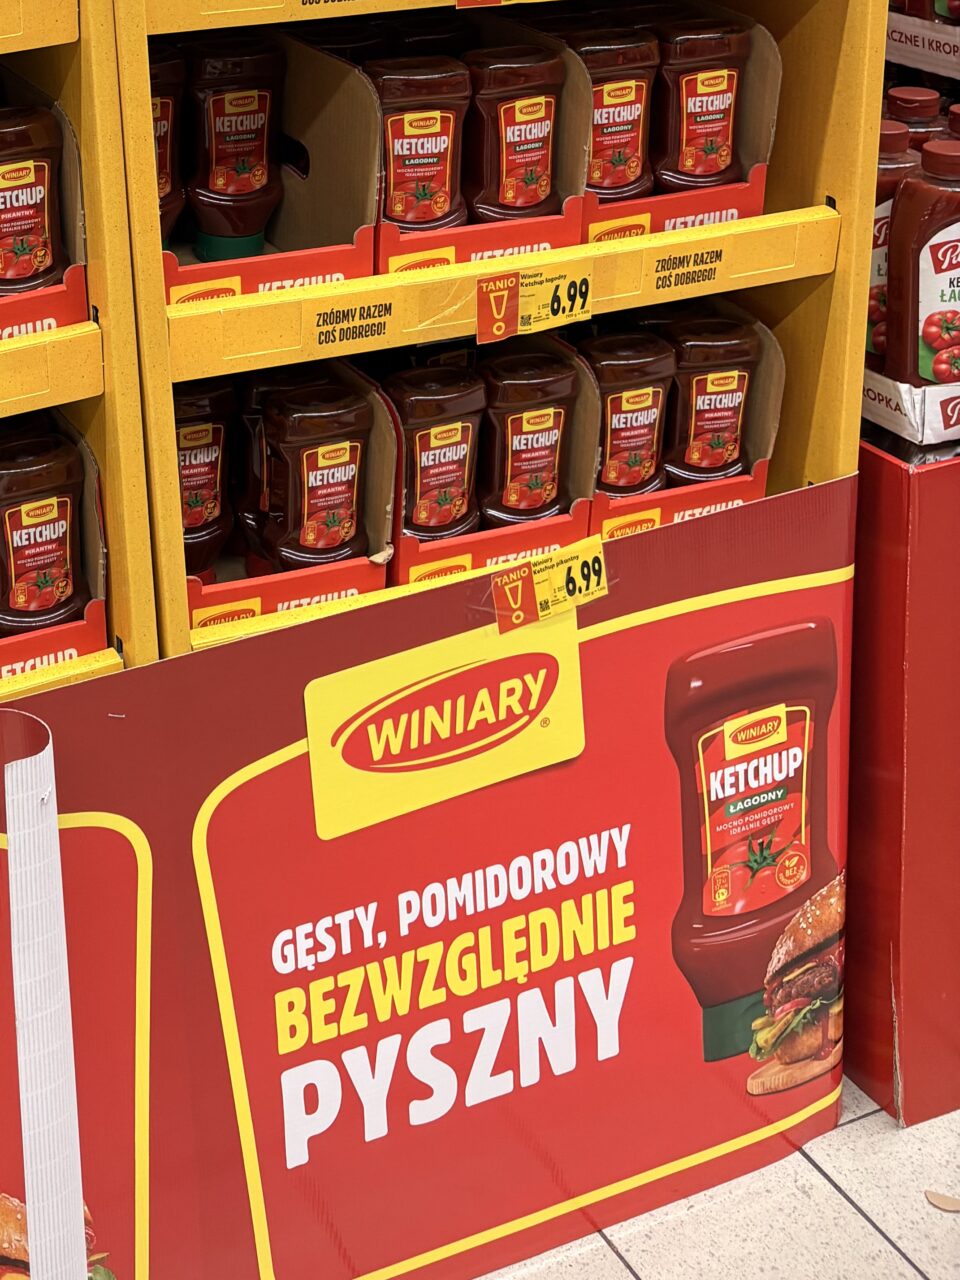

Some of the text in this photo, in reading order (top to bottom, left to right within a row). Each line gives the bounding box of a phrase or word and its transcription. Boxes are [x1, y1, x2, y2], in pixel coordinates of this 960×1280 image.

[394, 135, 448, 155] KETCHUP
[480, 277, 516, 292] TANIO
[550, 277, 590, 316] 6.99
[611, 407, 658, 429] KETCHUP
[308, 464, 356, 488] KETCHUP
[12, 521, 67, 548] KETCHUP
[495, 567, 529, 586] TANIO
[565, 556, 602, 597] 6.99
[367, 667, 548, 762] WINIARY
[737, 720, 779, 742] WINIARY
[710, 746, 803, 801] KETCHUP
[729, 789, 784, 813] ŁAGODNY
[716, 802, 795, 832] MOCNO POMIDOROWY
[730, 813, 783, 835] IDEALNIE GĘSTY
[270, 903, 388, 973] GĘSTY,
[397, 824, 632, 937] POMIDOROWY
[274, 879, 637, 1055] BEZWZGLĘDNIE
[280, 956, 635, 1170] PYSZNY
